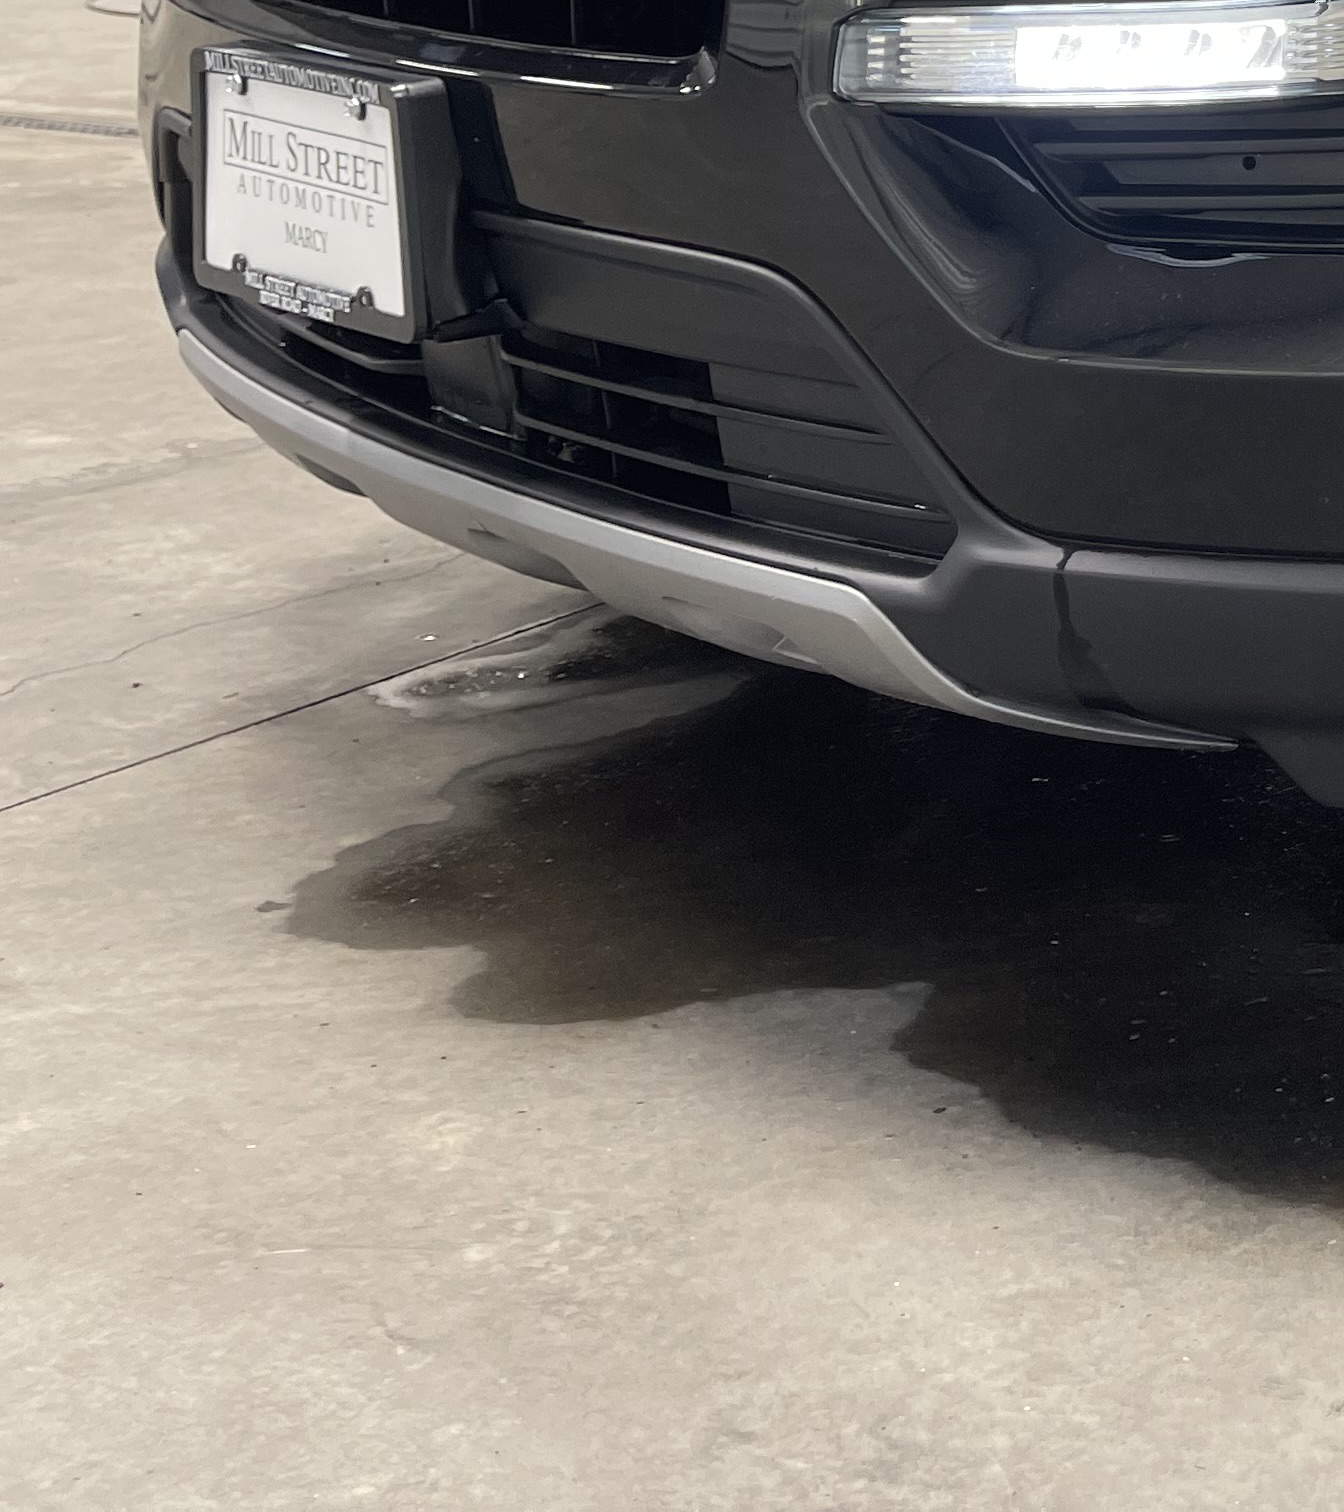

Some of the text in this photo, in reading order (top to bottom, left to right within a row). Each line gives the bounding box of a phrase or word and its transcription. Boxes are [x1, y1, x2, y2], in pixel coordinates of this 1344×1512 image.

[228, 117, 384, 195] MILL STREET
[237, 173, 376, 228] AUTOMOTIVE
[284, 220, 329, 254] MARCY
